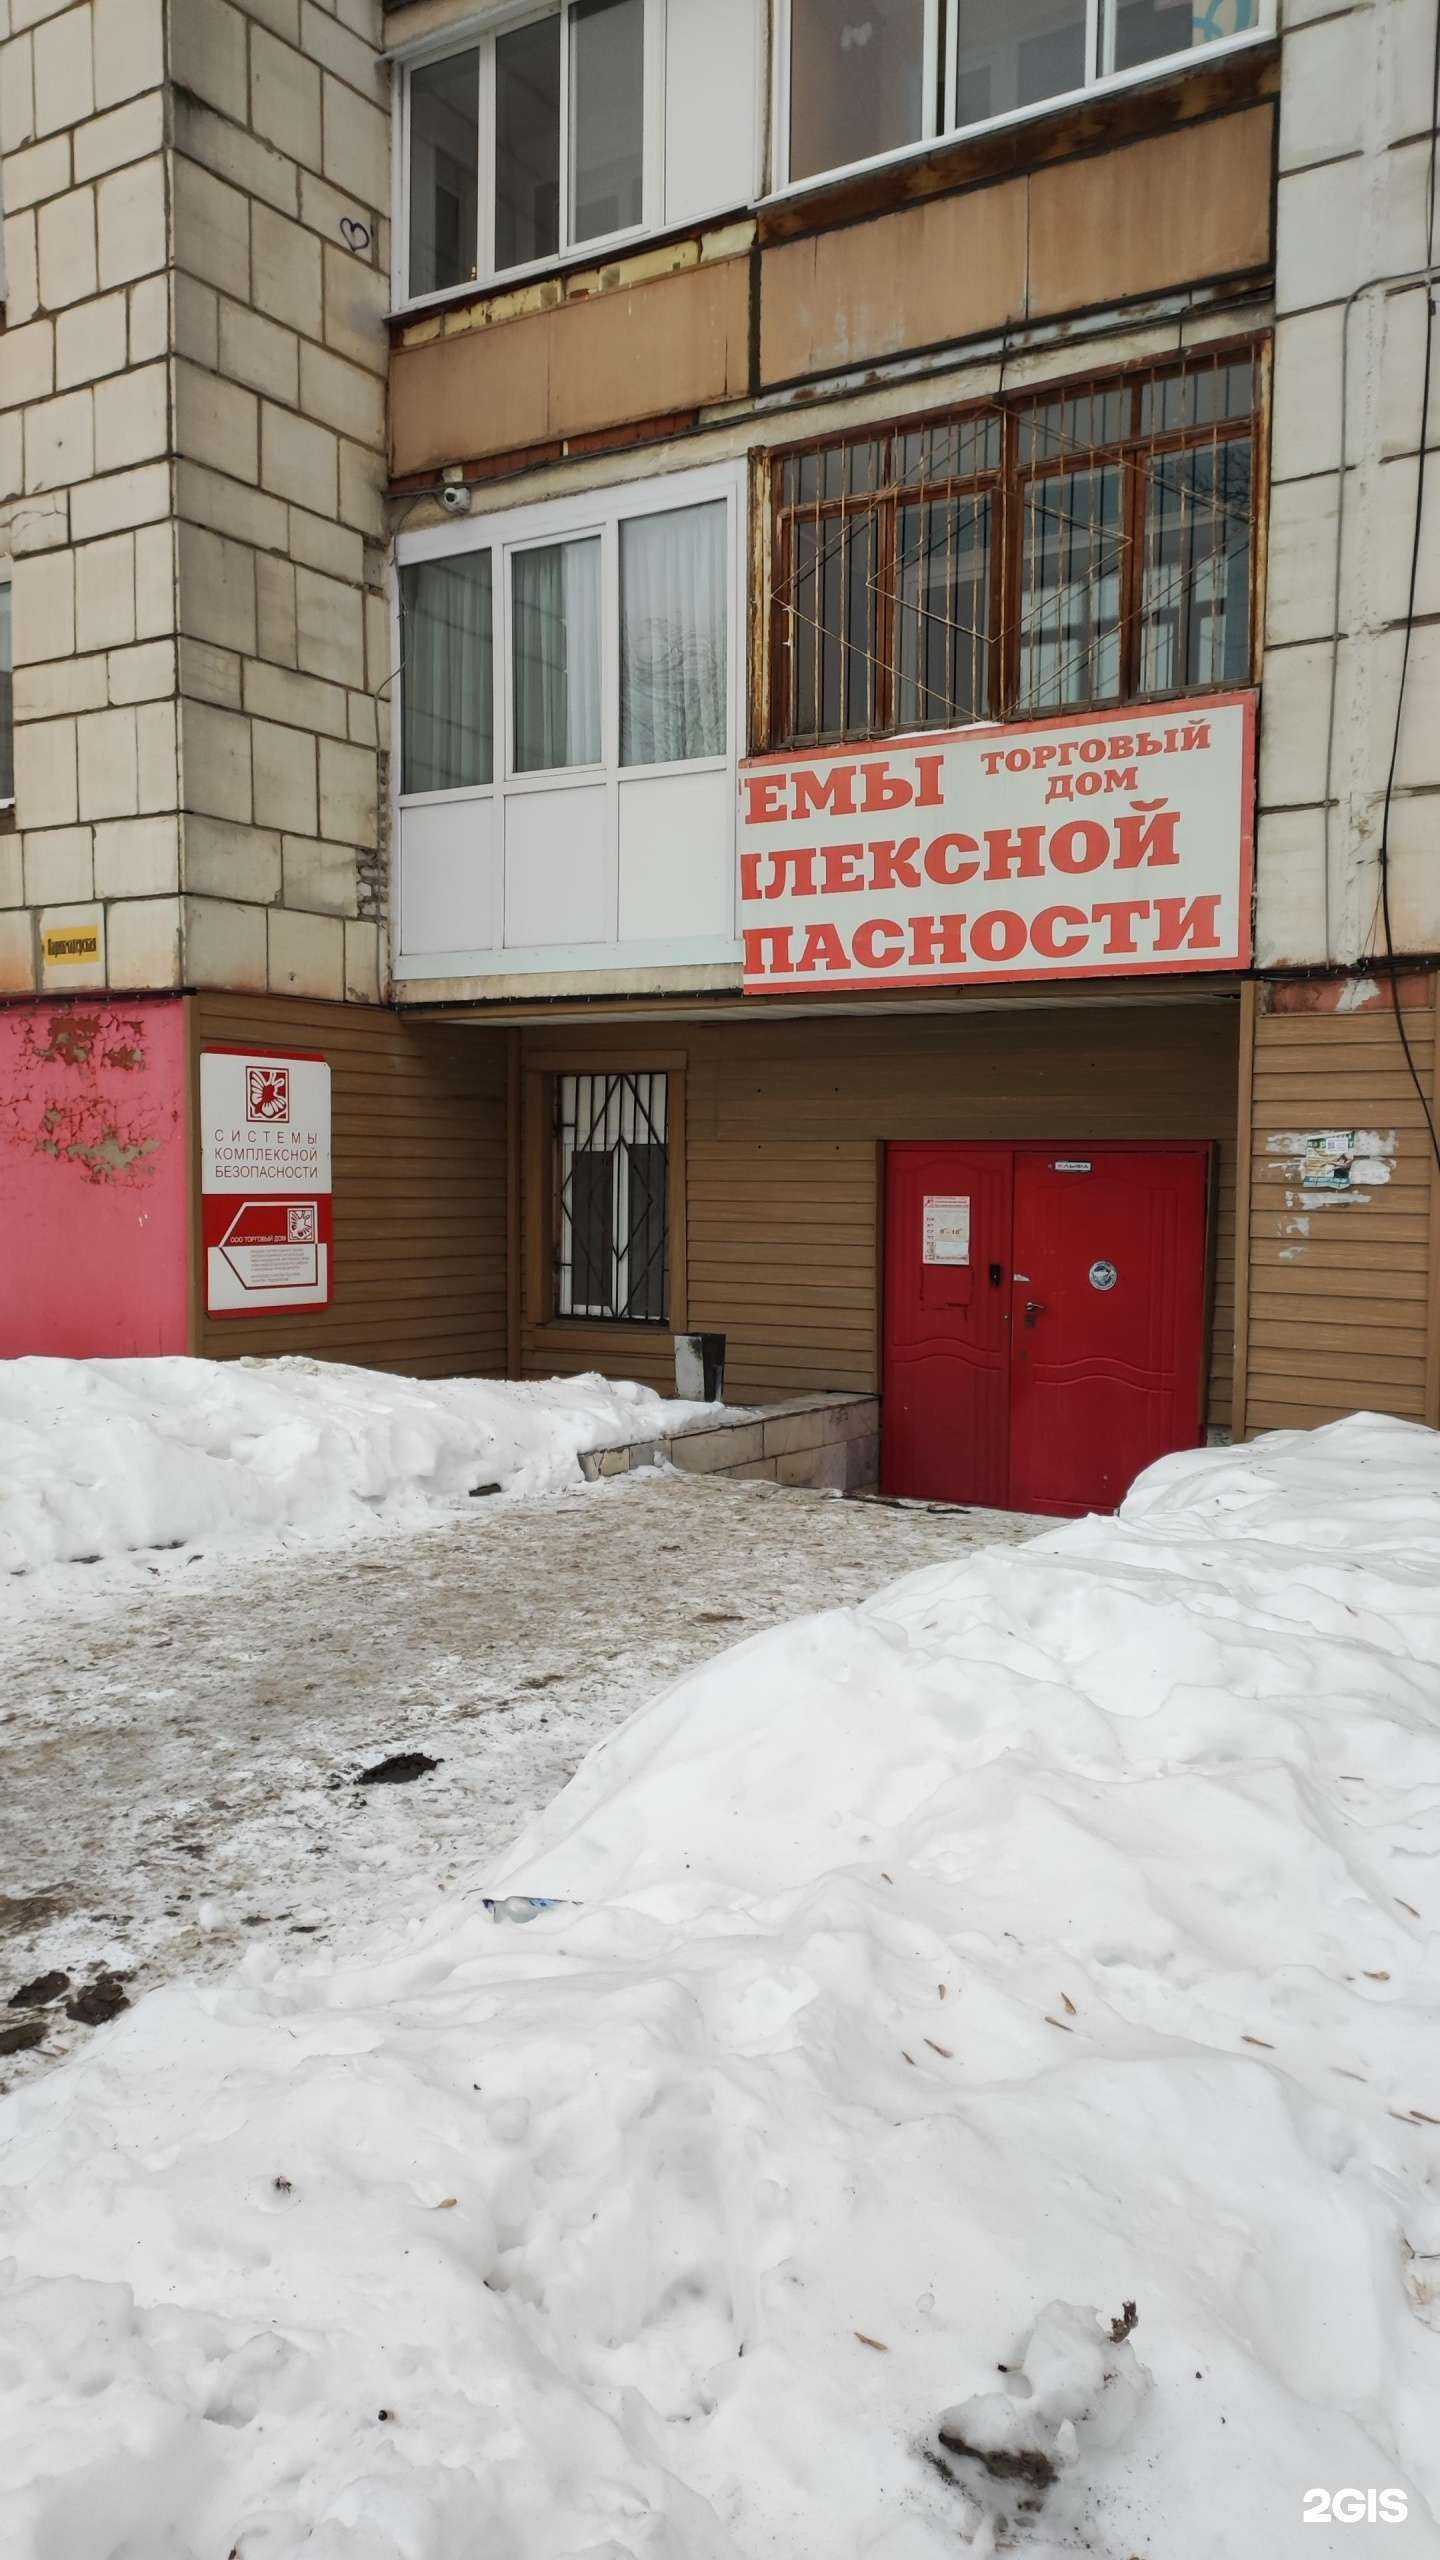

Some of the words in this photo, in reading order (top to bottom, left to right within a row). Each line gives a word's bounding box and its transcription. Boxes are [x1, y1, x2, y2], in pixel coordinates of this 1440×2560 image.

[980, 718, 1212, 776] ТОРГОВЫЙ
[738, 755, 945, 825] ЕМЫ
[1044, 766, 1139, 804] ДОМ
[743, 894, 1221, 974] ПАСНОСТИ
[214, 1129, 318, 1145] СИСТЕМЫ
[214, 1147, 318, 1161] КОМПЛЕКСНОЙ
[215, 1165, 318, 1178] БЕЗОПАСНОСТИ
